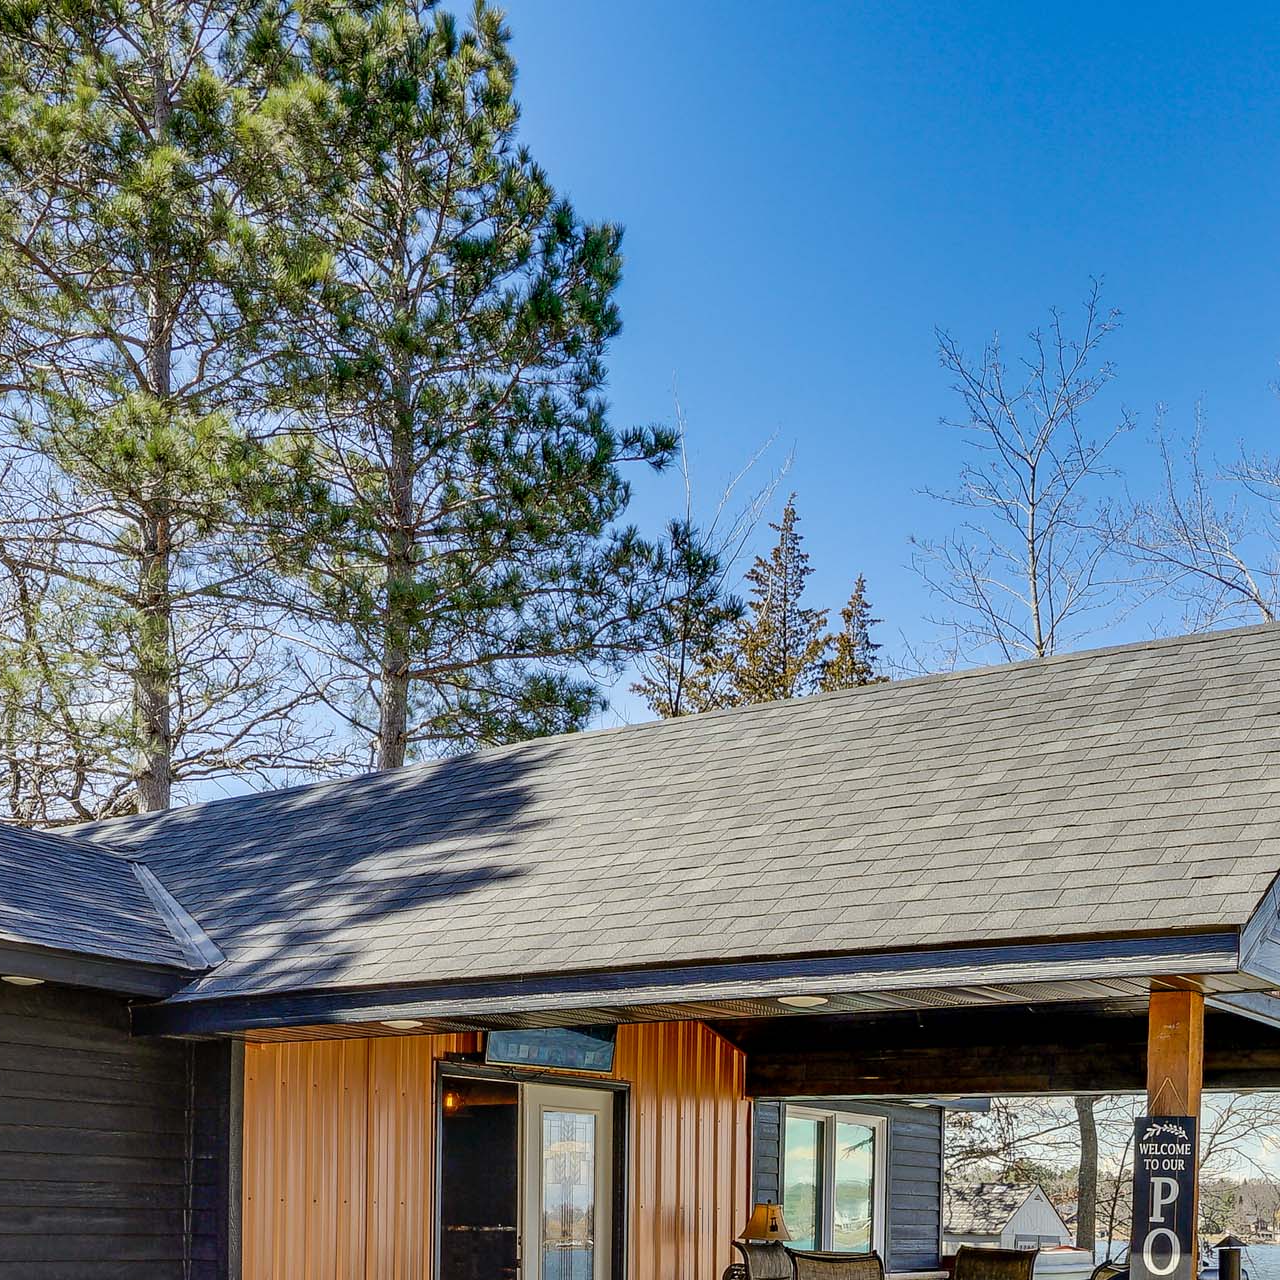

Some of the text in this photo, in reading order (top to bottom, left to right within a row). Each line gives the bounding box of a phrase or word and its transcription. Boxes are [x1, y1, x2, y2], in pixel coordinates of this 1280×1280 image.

[1139, 1143, 1192, 1155] WELCOME
[1143, 1158, 1186, 1171] TO OUR
